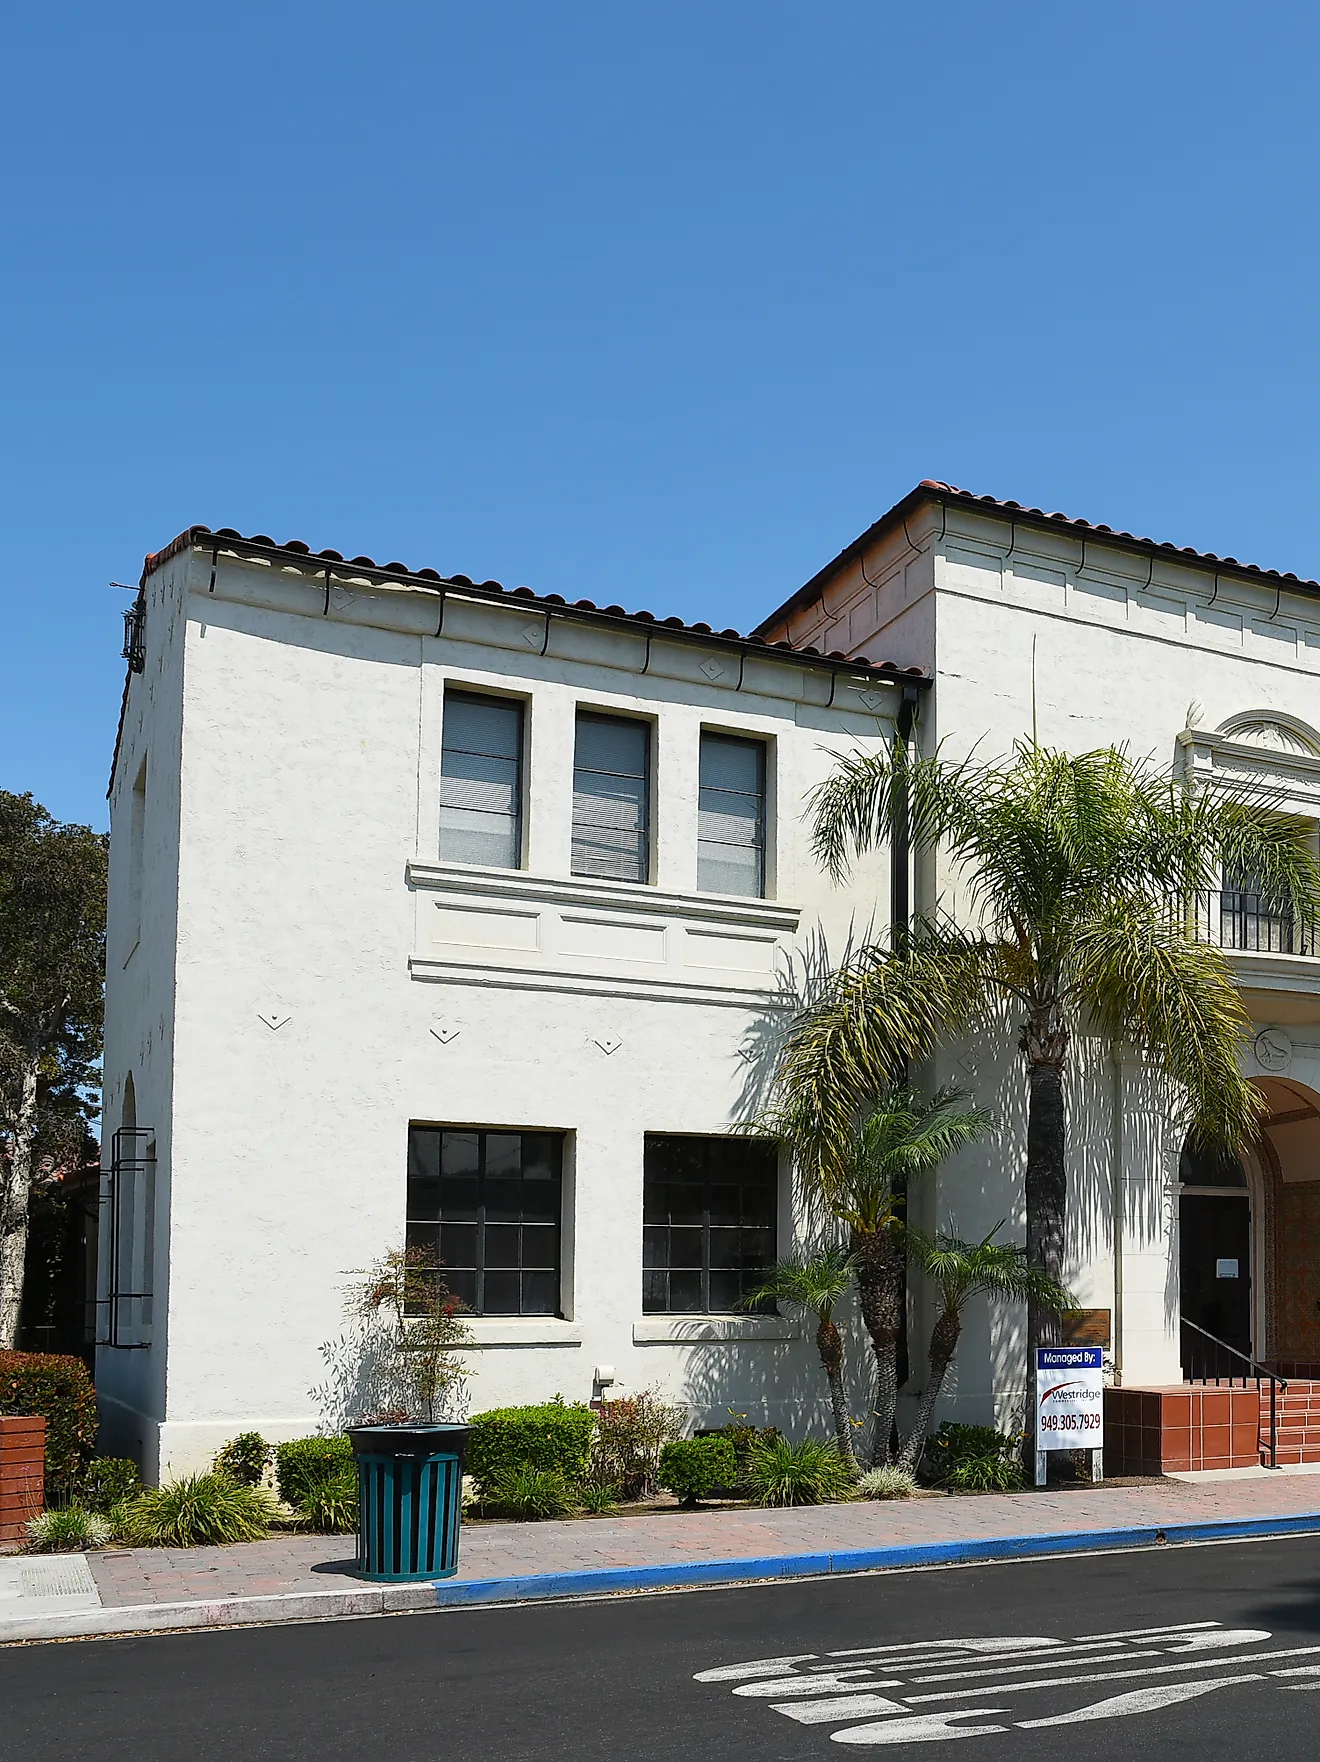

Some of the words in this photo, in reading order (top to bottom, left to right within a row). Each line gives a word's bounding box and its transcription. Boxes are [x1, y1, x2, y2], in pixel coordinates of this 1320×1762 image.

[1044, 1352, 1082, 1365] Managed
[1084, 1352, 1096, 1364] By:
[1052, 1389, 1101, 1401] Westridge
[1041, 1414, 1100, 1431] 949.305.7929
